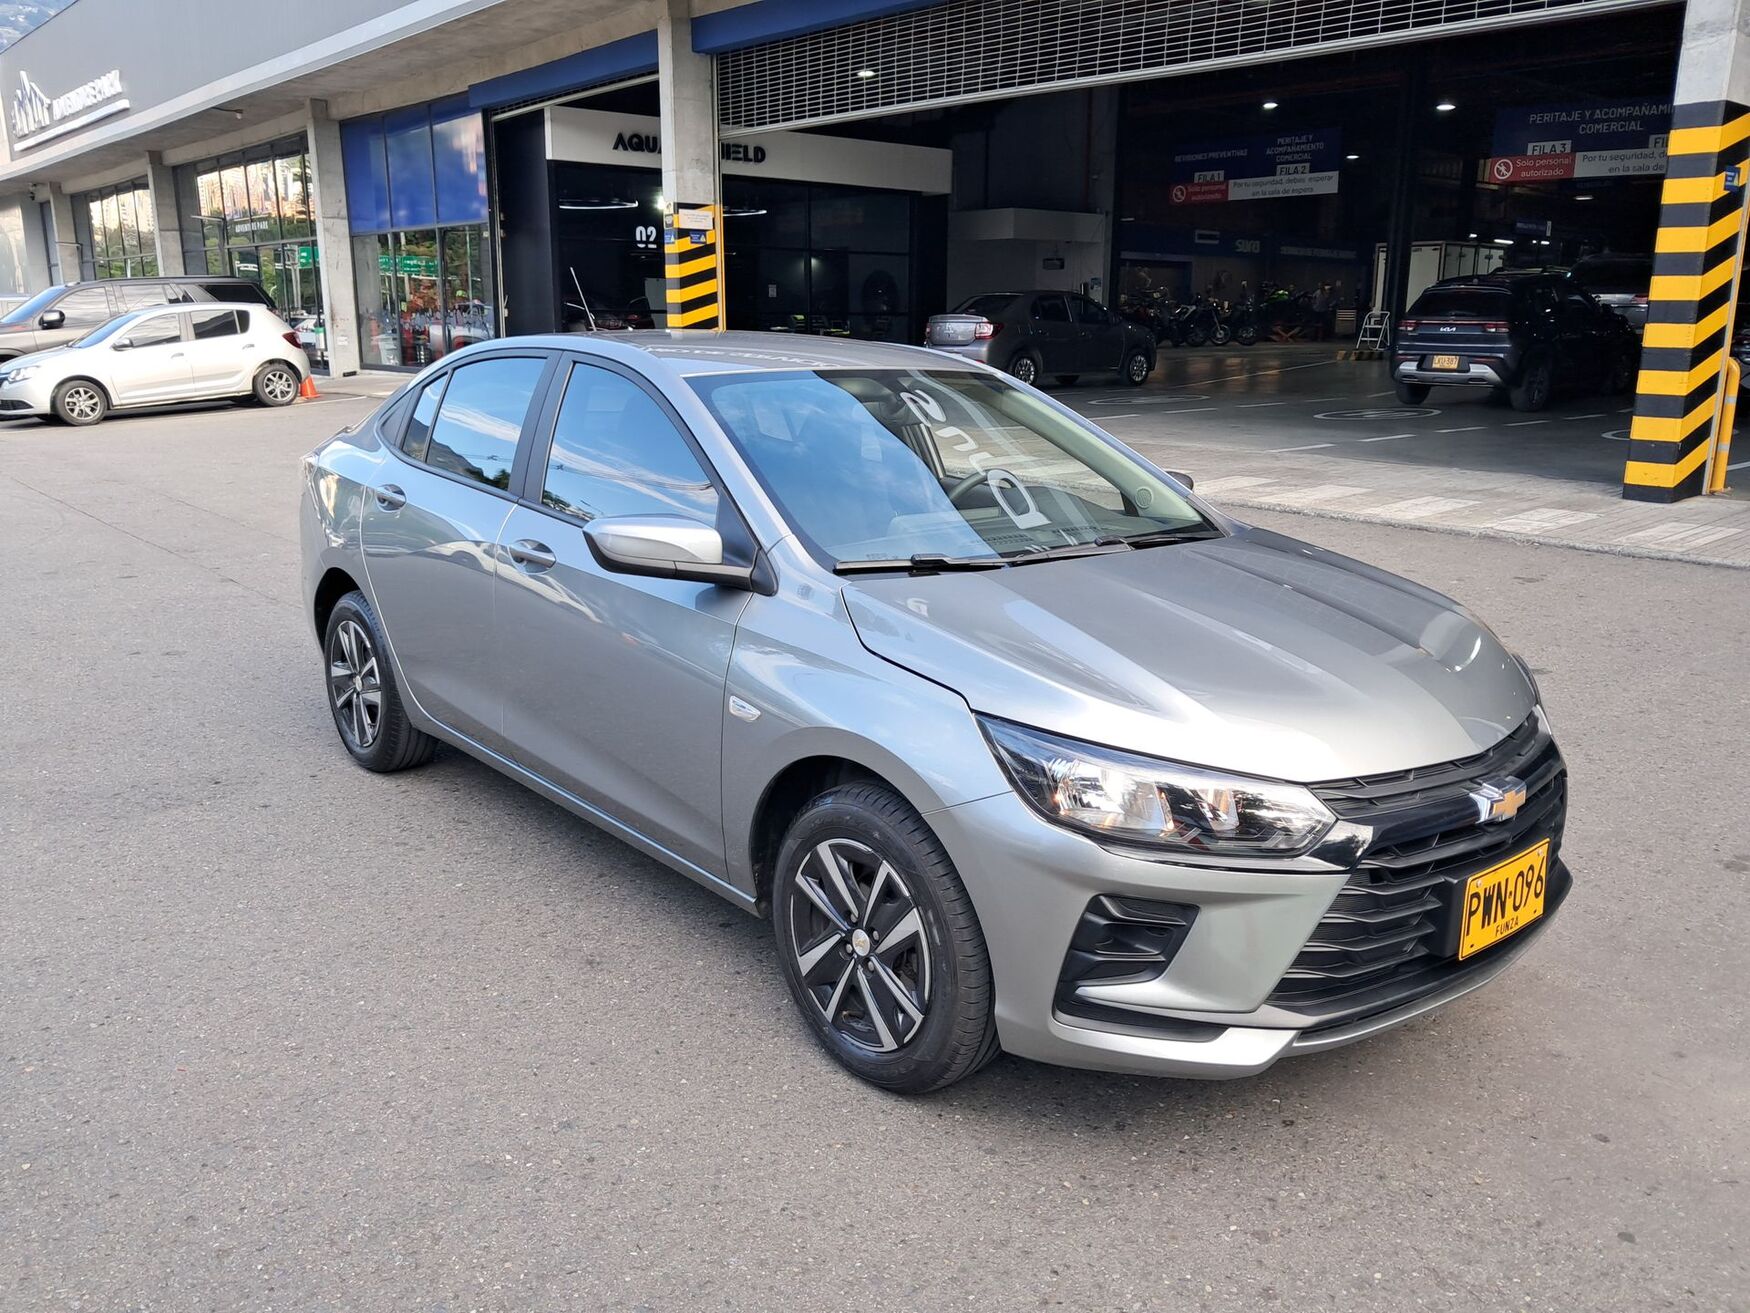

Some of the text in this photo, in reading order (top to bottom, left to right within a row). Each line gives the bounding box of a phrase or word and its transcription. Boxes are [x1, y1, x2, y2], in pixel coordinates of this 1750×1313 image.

[1529, 103, 1673, 124] PERITAJE Y ACOMPAÑAMI
[1579, 121, 1644, 135] COMERCIAL
[613, 132, 661, 154] AQU
[1531, 143, 1566, 155] FILA 3
[1516, 156, 1571, 168] Solo personal
[1582, 153, 1597, 162] Por
[1598, 153, 1606, 162] tu
[1280, 165, 1307, 175] FILA 2
[1520, 168, 1564, 177] autorizado
[1608, 162, 1664, 174] en la sala de
[635, 226, 657, 249] 02
[1495, 915, 1519, 937] FUNZA
